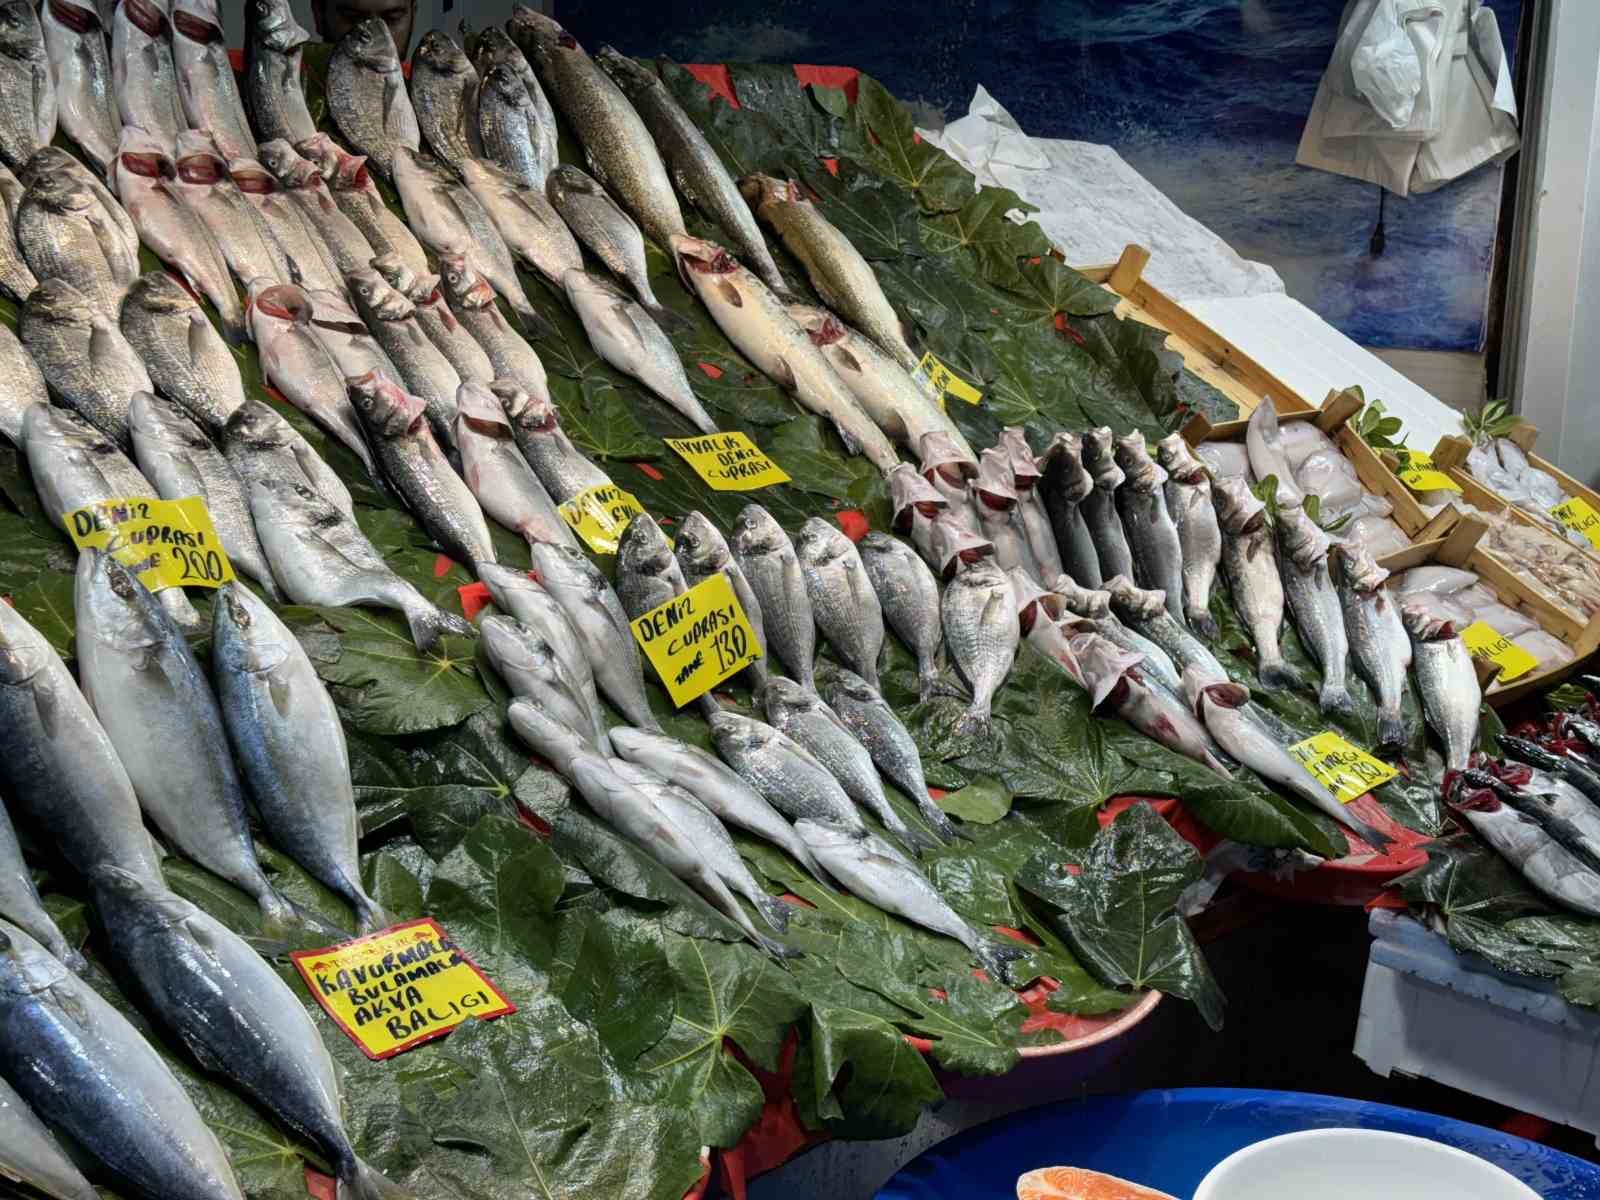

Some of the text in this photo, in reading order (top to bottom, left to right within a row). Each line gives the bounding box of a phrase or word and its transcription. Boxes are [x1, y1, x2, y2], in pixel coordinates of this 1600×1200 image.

[172, 547, 223, 581] 200
[710, 624, 747, 675] 130
[354, 986, 423, 1026] AKYA
